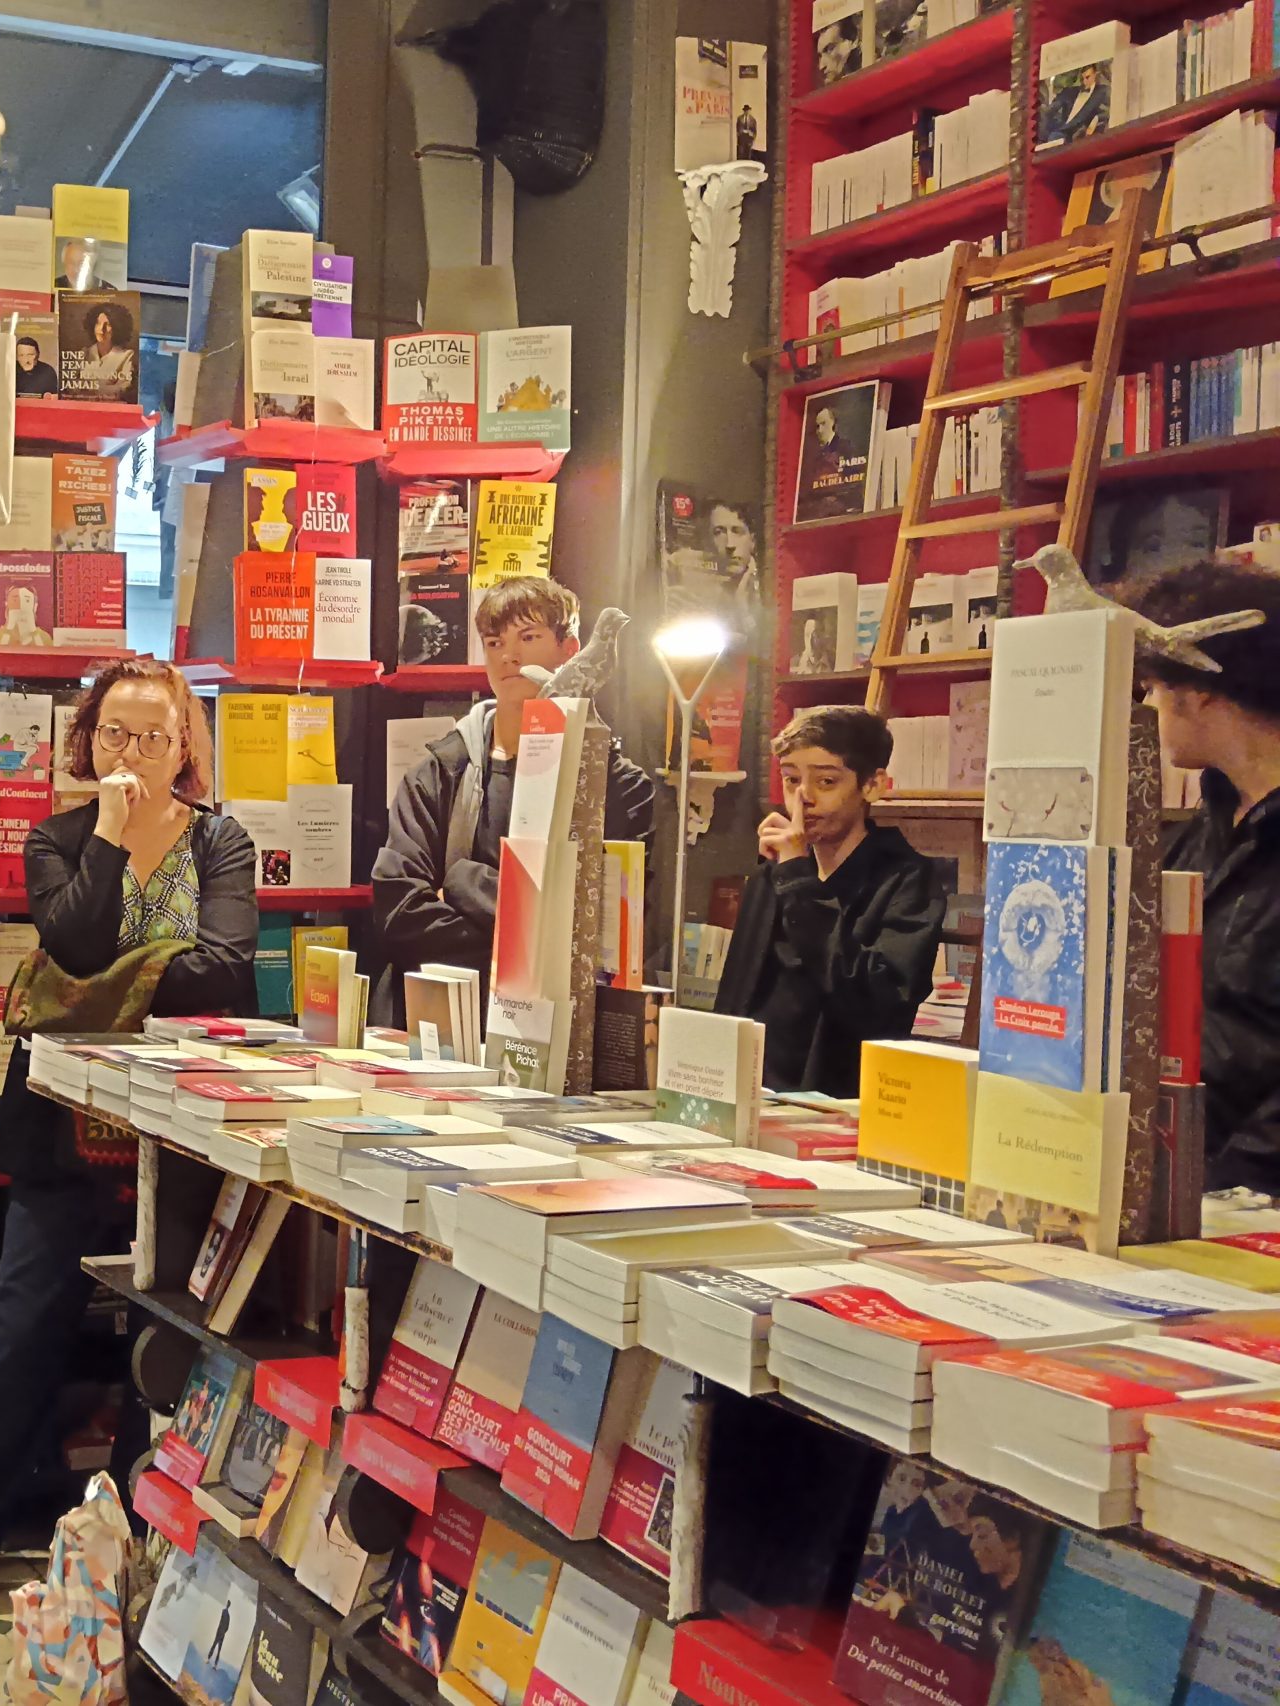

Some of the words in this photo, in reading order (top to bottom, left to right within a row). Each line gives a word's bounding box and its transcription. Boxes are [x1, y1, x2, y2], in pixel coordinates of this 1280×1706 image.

[266, 270, 307, 283] Palestine
[313, 281, 348, 290] CIVILISATION
[394, 339, 470, 356] CAPITAL
[61, 351, 85, 361] UNE
[394, 353, 470, 368] IDÉOLOGIE
[61, 370, 77, 380] NE
[60, 380, 100, 391] JAMAIS
[400, 406, 464, 416] THOMAS
[399, 416, 465, 426] PIKETTY
[389, 429, 399, 442] EN
[402, 427, 430, 442] BANDE
[838, 456, 867, 468] PARIS
[65, 466, 107, 477] TAXEZ
[812, 472, 866, 489] BAUDELAIRE
[307, 491, 336, 512] LES
[408, 495, 460, 507] PROFEON
[499, 494, 510, 504] UNE
[511, 494, 537, 504] HISTOIRE
[76, 505, 101, 513] JUSTICE
[489, 504, 544, 527] AFRICAINE
[77, 514, 102, 522] FISCALE
[302, 512, 350, 533] GUEUX
[497, 526, 505, 535] DE
[506, 525, 534, 537] L'AFRIQUE
[265, 571, 296, 584] PIERRE
[337, 566, 352, 574] TIROLE
[250, 585, 311, 598] ROSANVALLON
[318, 592, 359, 603] Économie
[250, 607, 266, 622] LA
[268, 607, 309, 623] TYRANNIE
[315, 604, 326, 612] du
[327, 604, 361, 613] désordre
[322, 613, 356, 623] mondial
[250, 625, 264, 639] DU
[266, 621, 309, 639] PRÉSENT
[6, 789, 48, 799] Continent
[310, 989, 330, 1004] Eden
[504, 997, 533, 1011] marché
[502, 1009, 517, 1020] noir
[505, 1040, 538, 1055] Bérénice
[516, 1053, 540, 1068] Pichat
[877, 1071, 912, 1091] Victoria
[997, 1131, 1012, 1146] La
[1016, 1136, 1084, 1162] Rédemption
[414, 1298, 455, 1325] l'absence
[423, 1319, 433, 1329] de
[502, 1318, 538, 1337] COLLISION
[412, 1328, 437, 1347] corps
[451, 1386, 475, 1408] PRIX
[443, 1410, 462, 1429] DES
[447, 1399, 502, 1434] GONCOURT
[439, 1424, 464, 1446] 2025
[526, 1426, 573, 1468] GONCOURT
[513, 1434, 524, 1449] DU
[523, 1443, 554, 1474] PREMIER
[554, 1467, 582, 1491] ROMAN
[918, 1552, 965, 1584] DANIEL
[913, 1571, 930, 1586] DE
[932, 1577, 987, 1610] ROULET
[951, 1603, 983, 1627] Trois
[928, 1612, 980, 1642] garçons
[870, 1635, 889, 1656] Par
[890, 1644, 933, 1680] l'auteur
[935, 1669, 950, 1686] de
[847, 1644, 869, 1664] Dix
[867, 1658, 904, 1684] petites
[904, 1677, 962, 1706] anarchist
[326, 1679, 355, 1706] SPECTR
